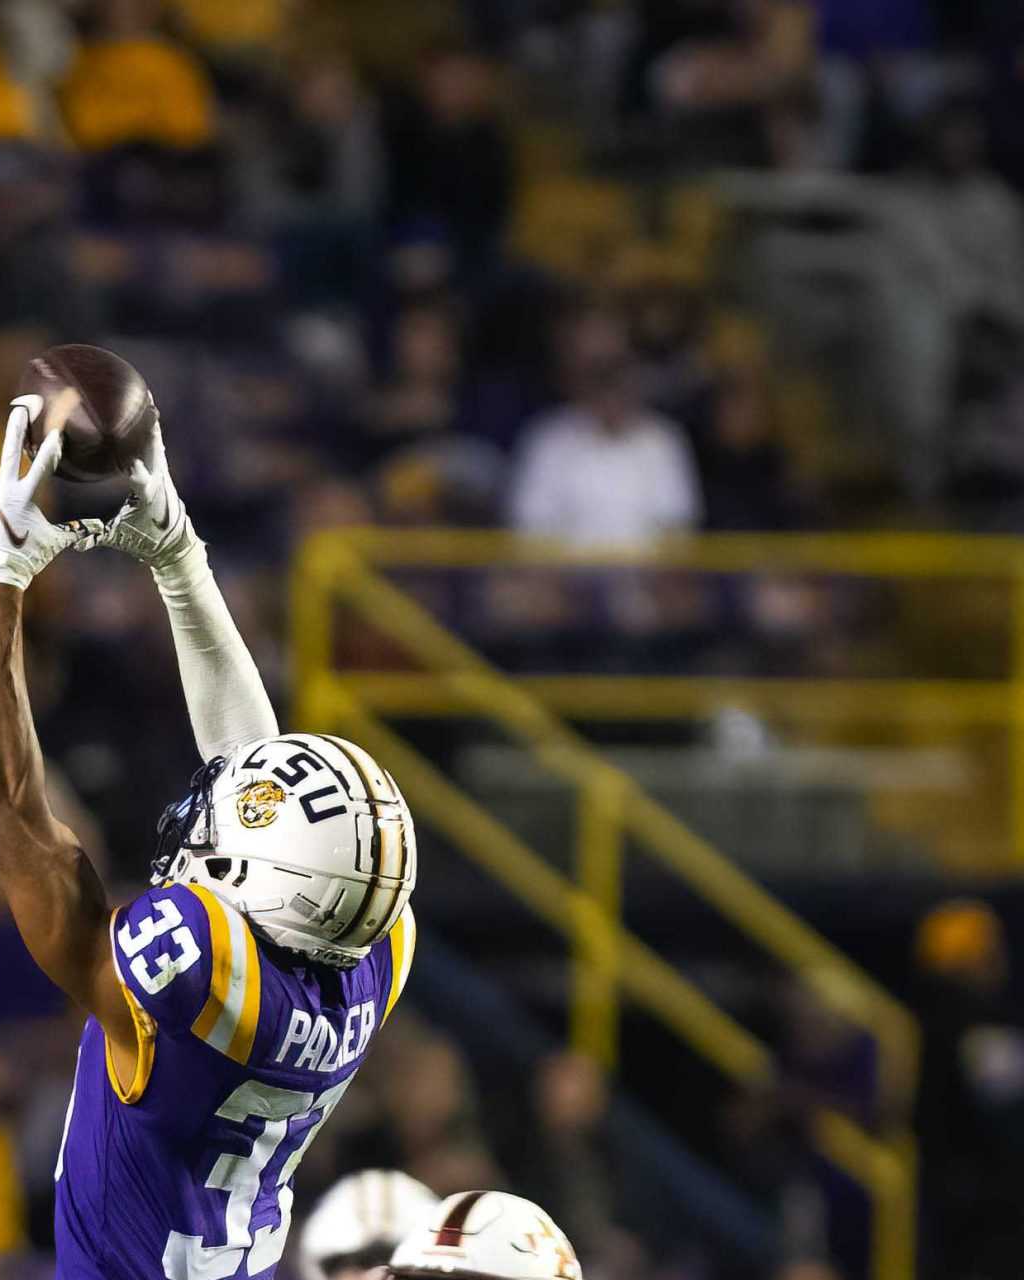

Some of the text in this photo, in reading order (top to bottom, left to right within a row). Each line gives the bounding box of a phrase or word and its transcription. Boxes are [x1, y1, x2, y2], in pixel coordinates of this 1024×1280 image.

[240, 743, 348, 824] LSU
[118, 897, 202, 996] 33
[274, 1000, 376, 1073] PALER
